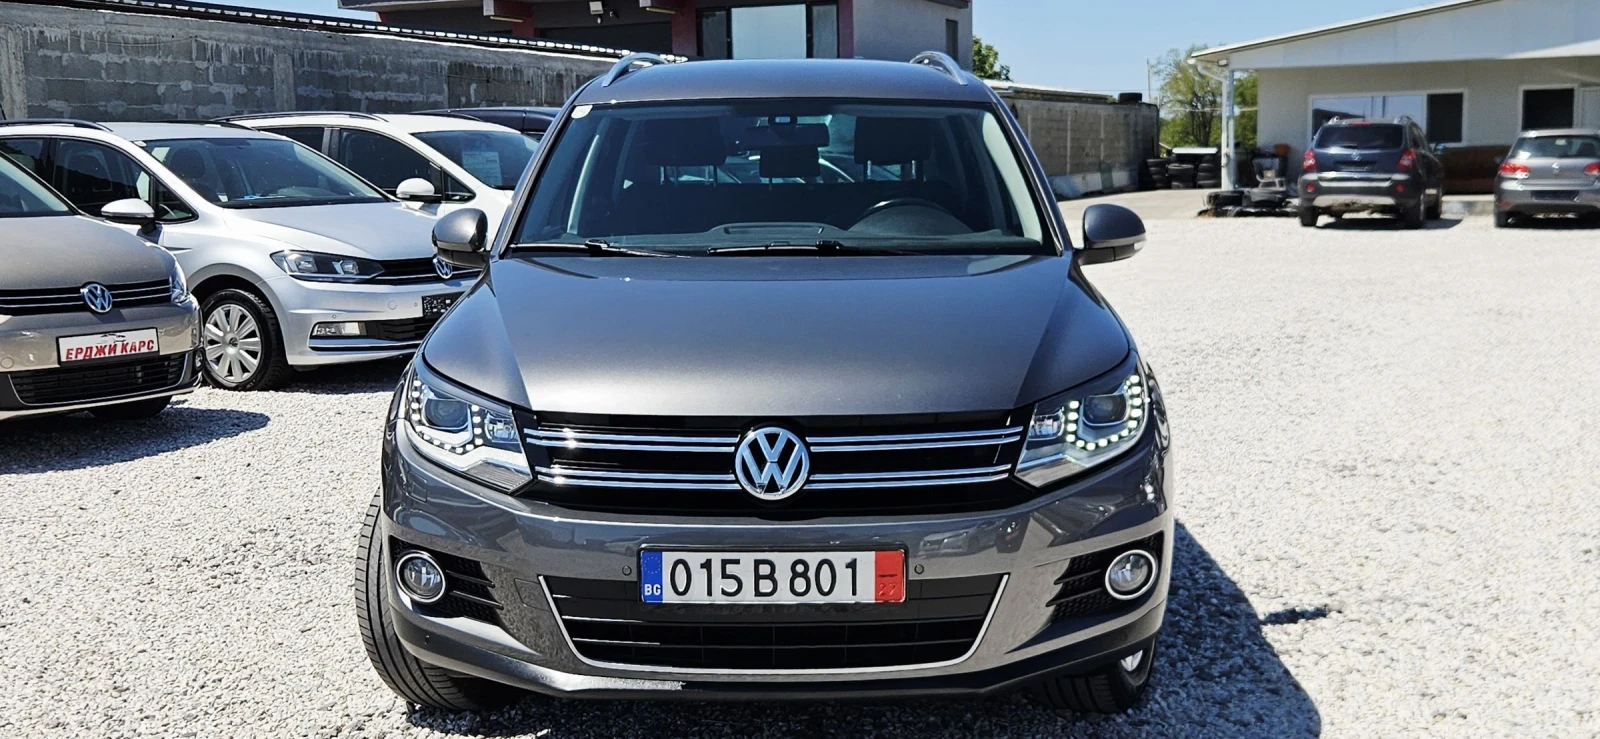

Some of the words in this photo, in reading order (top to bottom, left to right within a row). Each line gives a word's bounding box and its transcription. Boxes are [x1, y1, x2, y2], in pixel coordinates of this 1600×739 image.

[66, 343, 117, 360] ЕРДЖИ
[121, 339, 155, 353] КАРС
[735, 427, 809, 500] VW
[644, 584, 661, 596] BG
